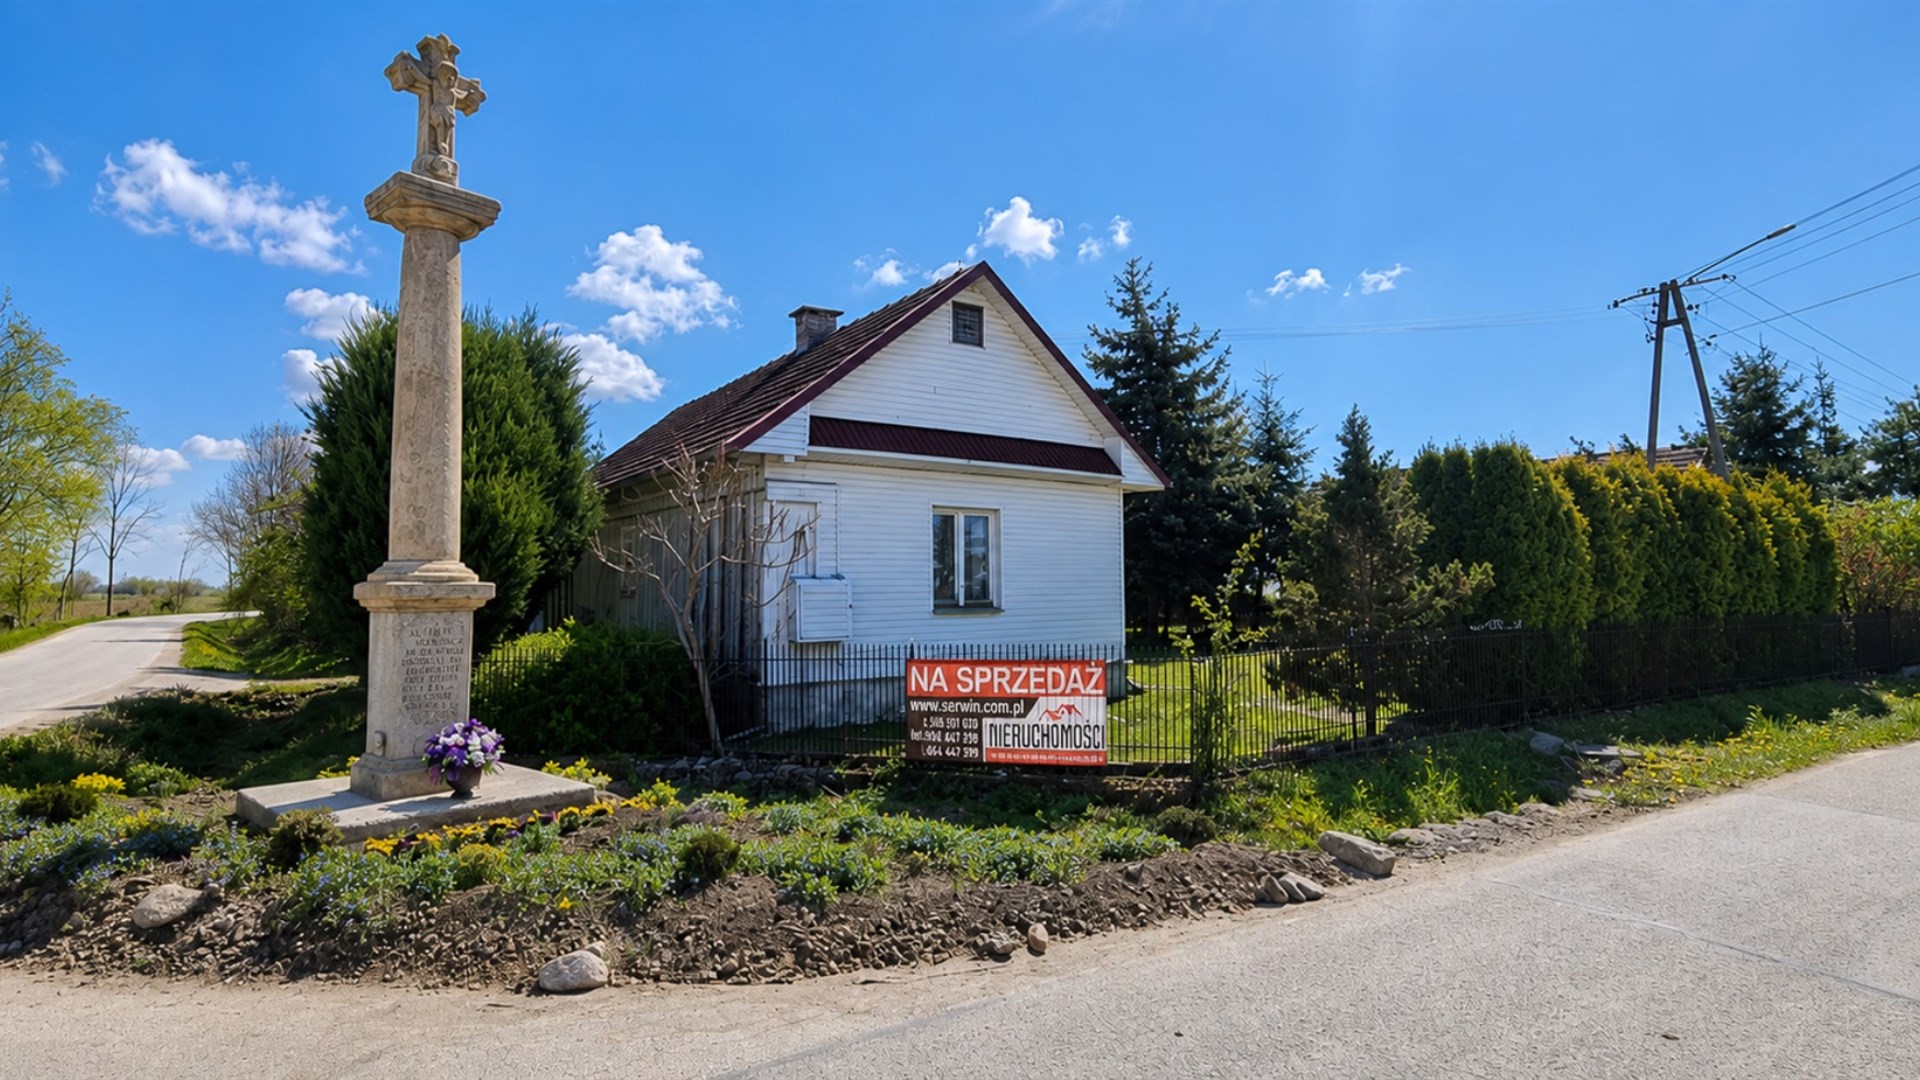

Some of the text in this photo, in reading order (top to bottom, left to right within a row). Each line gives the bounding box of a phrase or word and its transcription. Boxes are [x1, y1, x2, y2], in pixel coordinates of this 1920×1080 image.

[911, 661, 1104, 694] NA SPRZEDAŻ
[910, 699, 1025, 717] www.serwin.com.pl
[989, 719, 1105, 749] NIERUCHOMOŚCI
